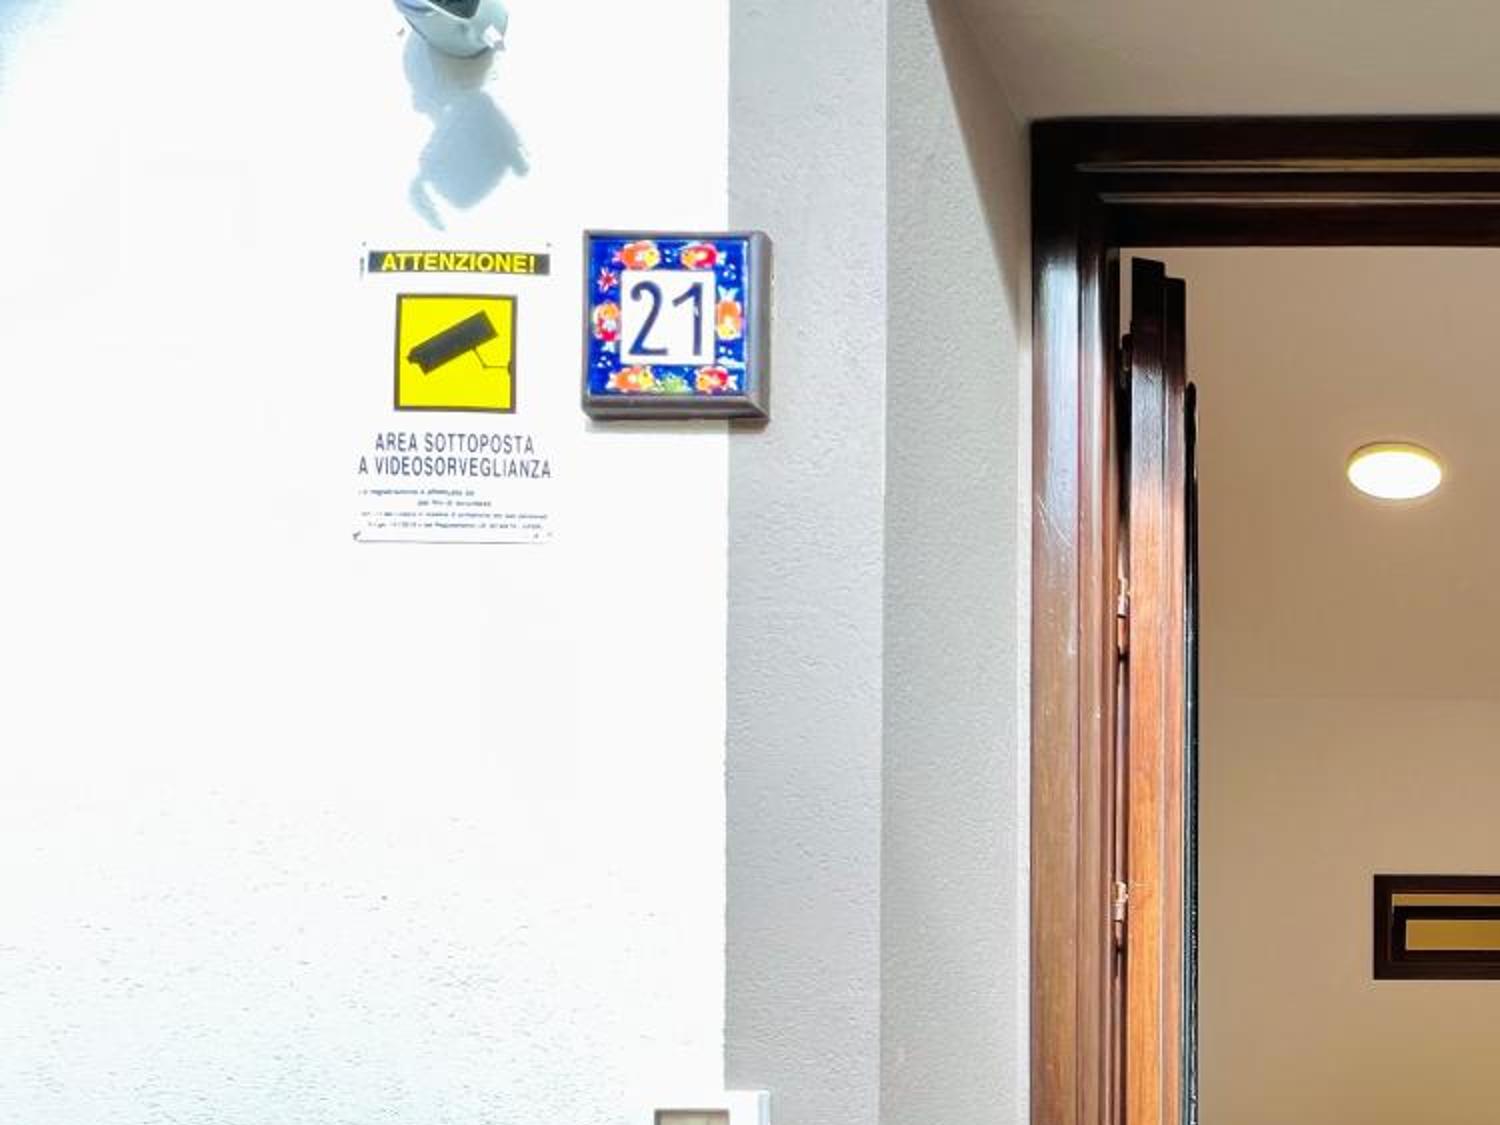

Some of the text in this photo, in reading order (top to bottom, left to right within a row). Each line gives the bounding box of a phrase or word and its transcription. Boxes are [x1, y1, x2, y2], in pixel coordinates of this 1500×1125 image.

[381, 252, 536, 274] ATTENZIONE!
[628, 281, 706, 357] 21
[375, 432, 535, 455] AREA SOTTOPOSTA
[358, 456, 551, 479] A VIDEOSORVEGLIANZA
